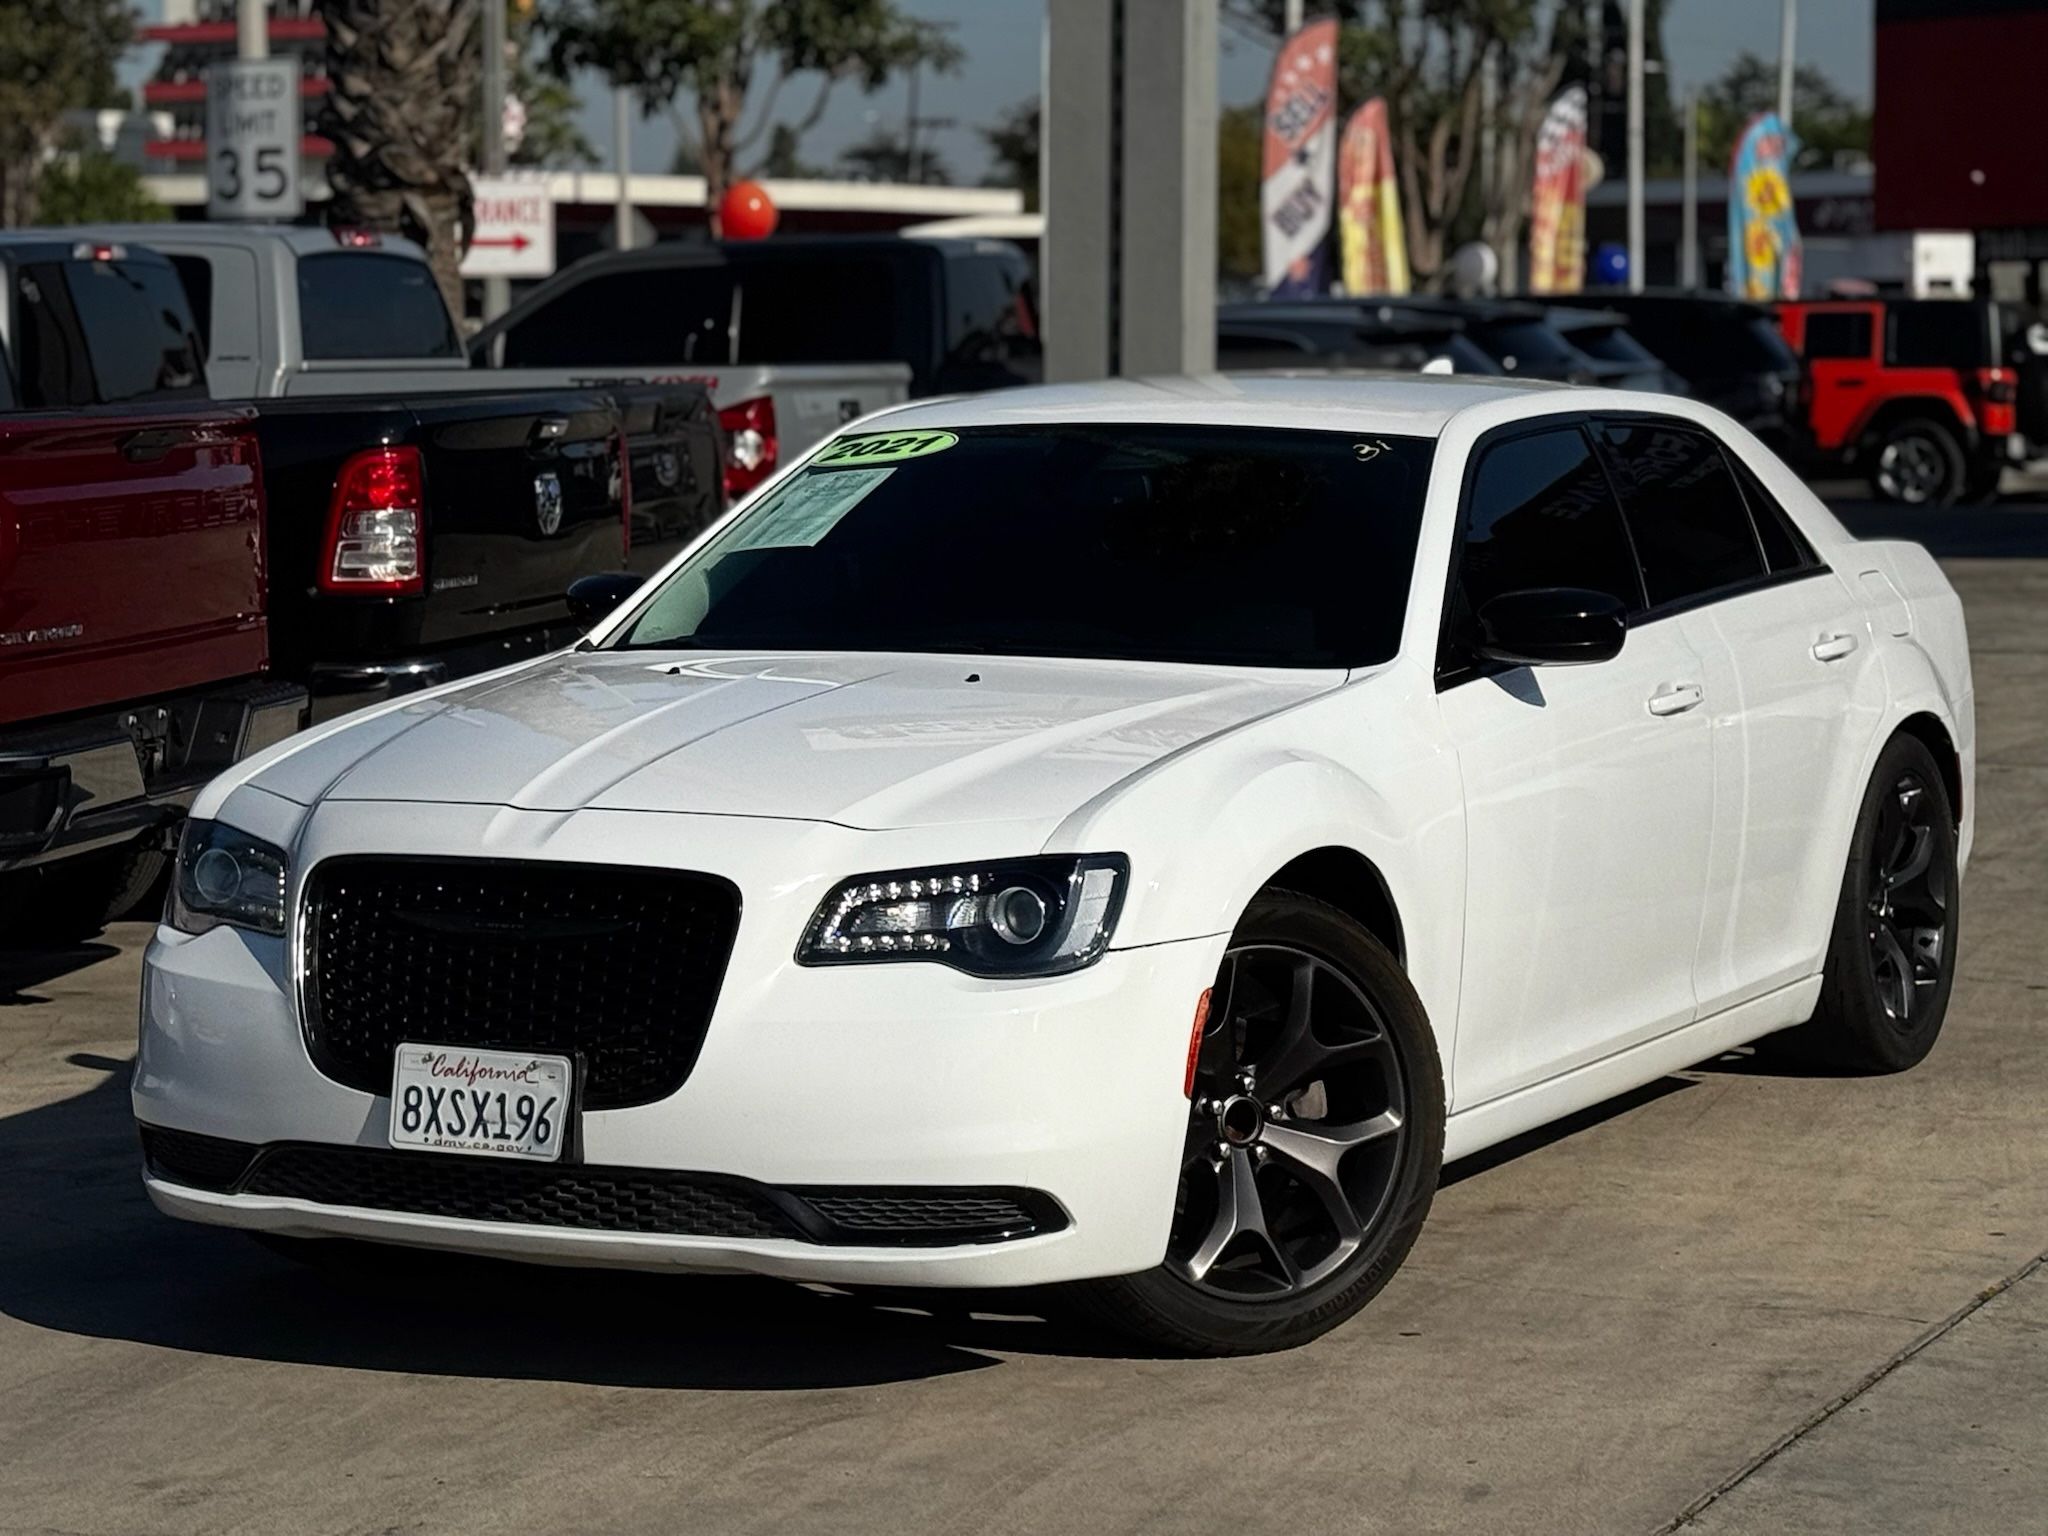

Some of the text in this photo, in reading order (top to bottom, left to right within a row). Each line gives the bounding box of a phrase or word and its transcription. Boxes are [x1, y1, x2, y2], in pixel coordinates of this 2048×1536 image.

[217, 147, 287, 200] 35
[1273, 178, 1323, 237] BUY
[818, 435, 945, 463] 2021
[431, 1053, 539, 1087] California
[402, 1085, 557, 1145] 8XSX196
[433, 1136, 524, 1152] dmv.ca.gov
